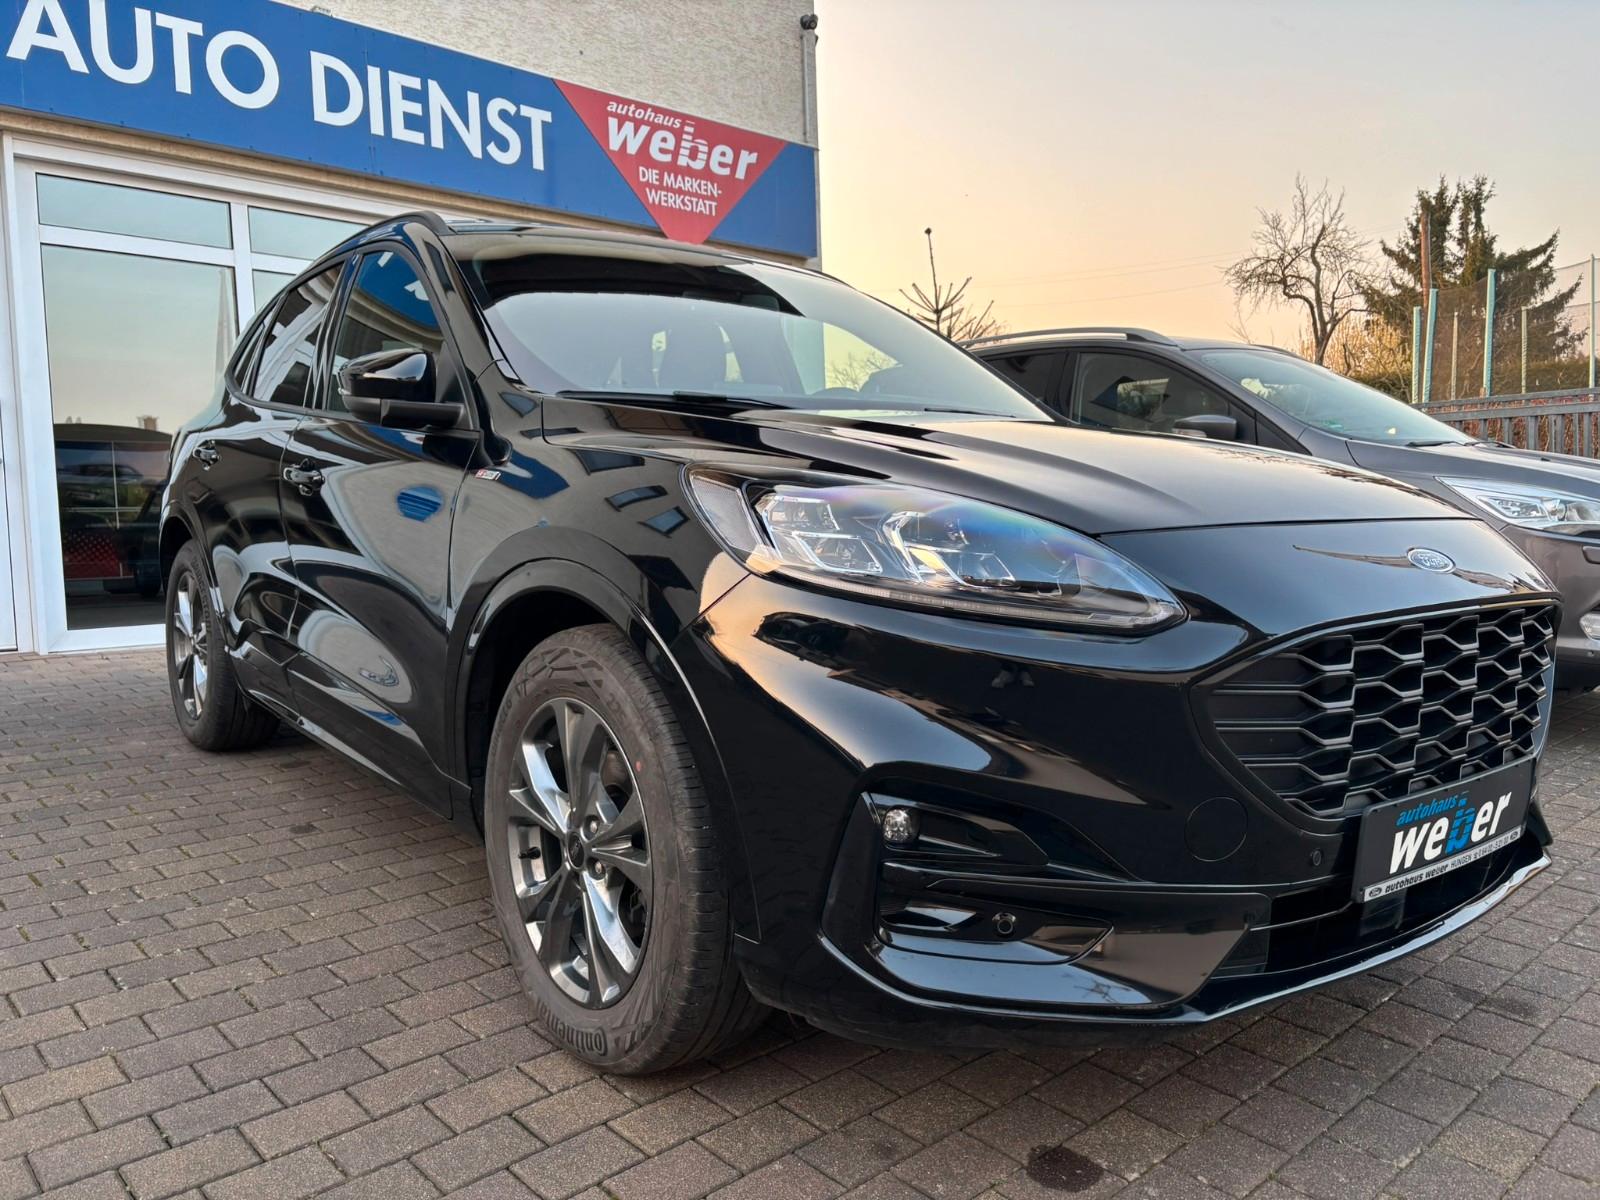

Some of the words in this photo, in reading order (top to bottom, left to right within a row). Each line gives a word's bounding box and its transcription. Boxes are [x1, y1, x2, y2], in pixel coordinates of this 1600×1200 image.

[6, 0, 280, 109] AUTO
[310, 50, 553, 171] DIENST
[606, 101, 682, 129] autohaus
[607, 116, 759, 180] weber
[638, 166, 660, 185] DIE
[663, 171, 723, 198] MARKEN-
[645, 187, 718, 217] WERKSTATT
[1396, 795, 1458, 827] autohaus
[1389, 791, 1512, 874] weber
